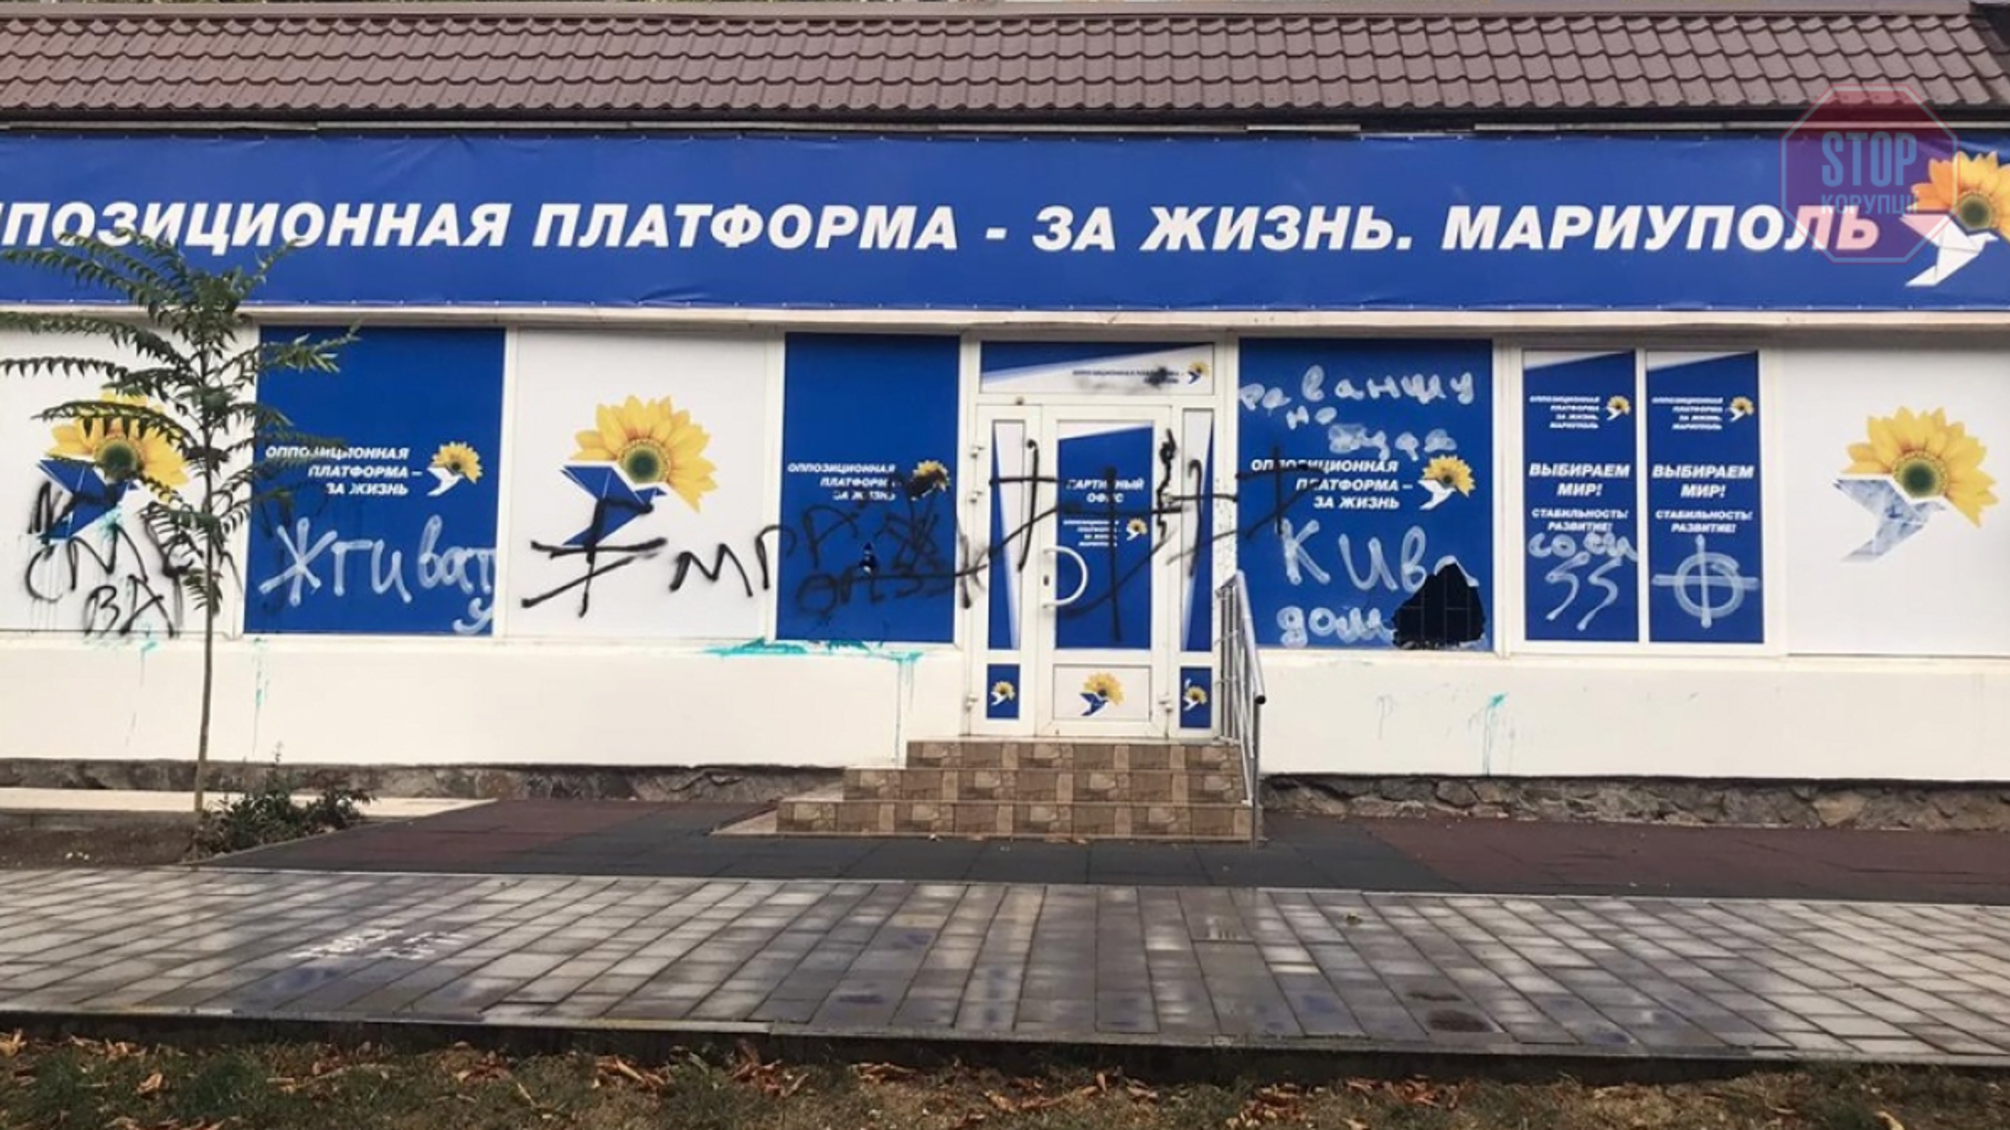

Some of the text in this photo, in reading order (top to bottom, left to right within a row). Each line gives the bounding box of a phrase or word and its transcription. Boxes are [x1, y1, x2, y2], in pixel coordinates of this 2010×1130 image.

[0, 201, 1880, 256] ПОЗИЦИОННАЯ ПЛАТФОРМА - ЗА ЖИЗНЬ. МАРИУПОЛЬ
[308, 464, 408, 478] ПЛАТФОРМА
[1529, 462, 1630, 478] ВЫБИРАЕМ
[1652, 464, 1755, 479] ВЫБИРАЕМ
[325, 482, 409, 495] ЗА ЖИЗНЬ
[1556, 483, 1603, 496] МИР!
[1680, 484, 1726, 498] МИР!
[1313, 496, 1400, 509] ЗА ЖИЗНЬ
[1547, 521, 1613, 532] РАЗВИТИЕ!
[1670, 523, 1737, 534] РАЗВИТИЕ!
